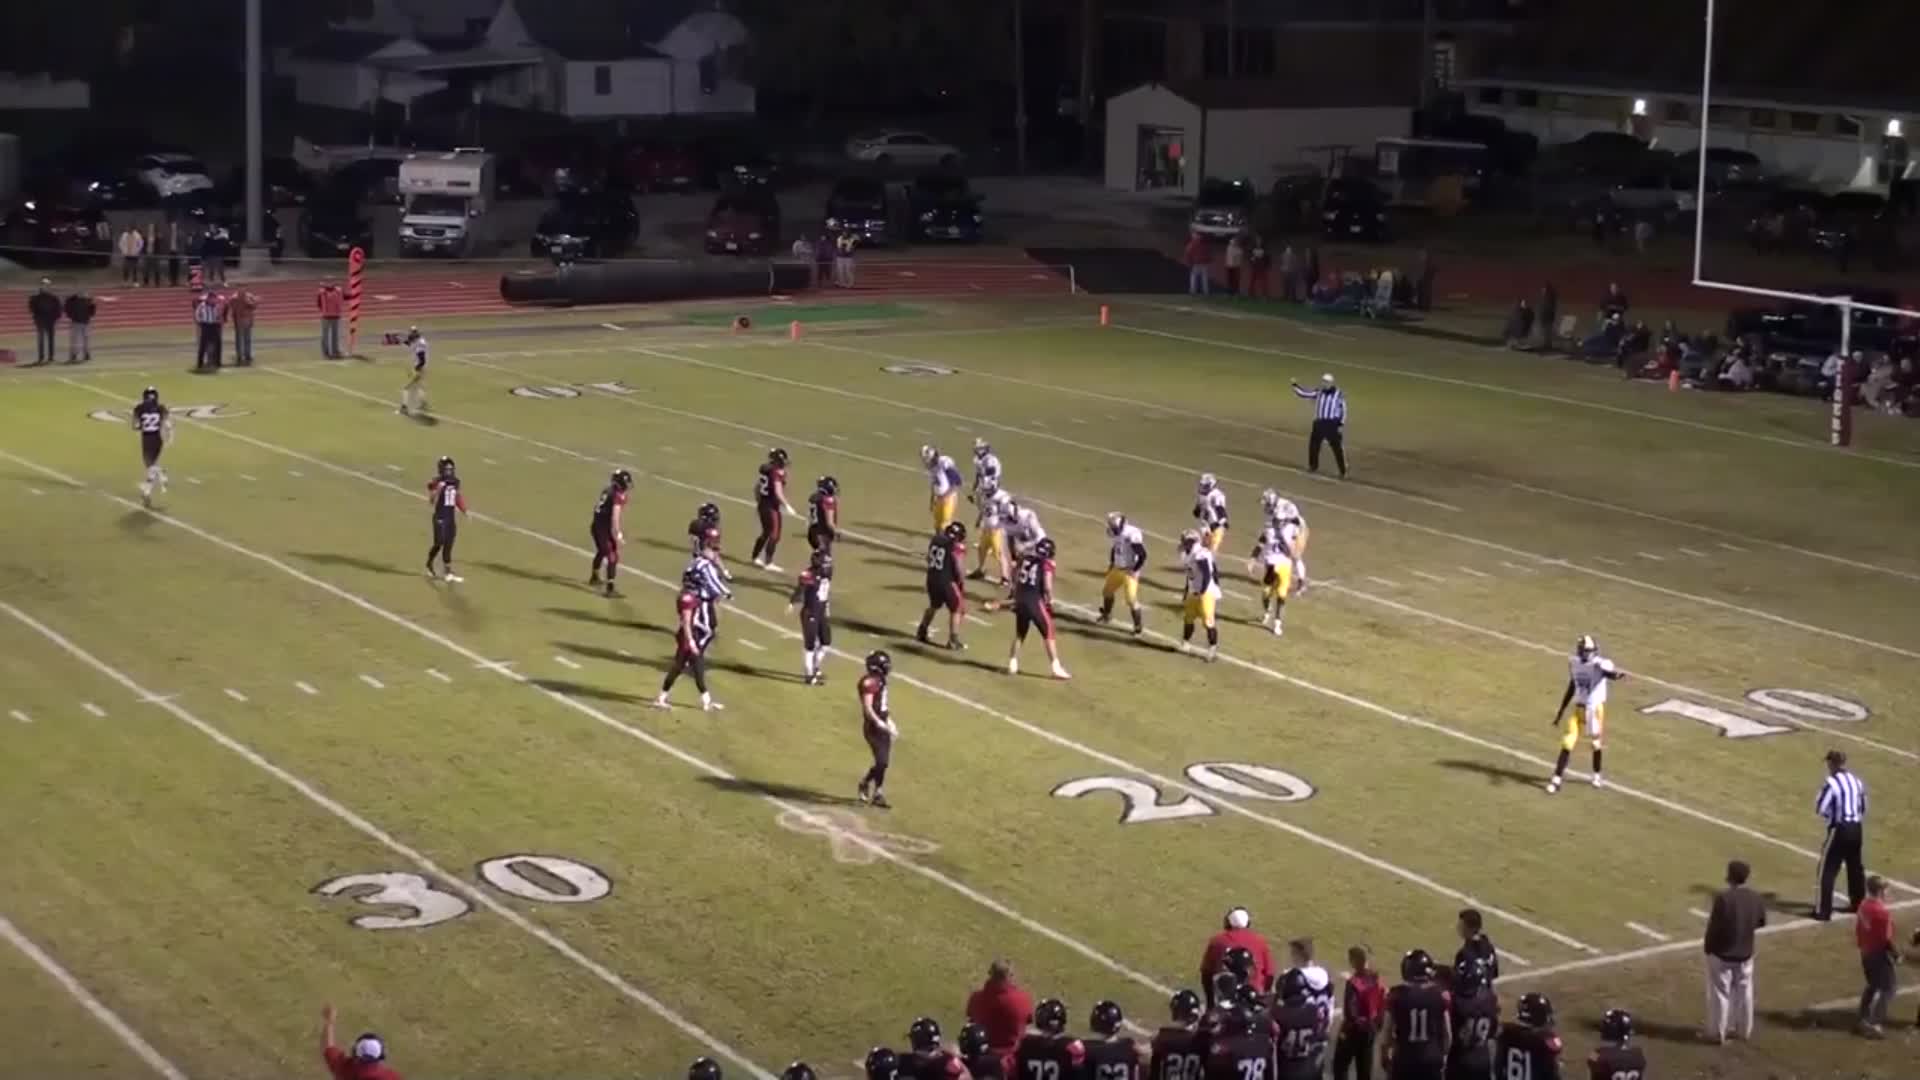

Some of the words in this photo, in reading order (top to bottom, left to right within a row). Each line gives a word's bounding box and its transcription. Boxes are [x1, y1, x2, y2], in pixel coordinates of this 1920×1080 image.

[140, 413, 161, 432] 22
[1020, 560, 1038, 586] 54
[1635, 687, 1872, 740] 10
[1050, 761, 1318, 823] 20
[310, 853, 613, 930] 30
[1408, 1008, 1428, 1042] 11
[1507, 1047, 1531, 1080] 61
